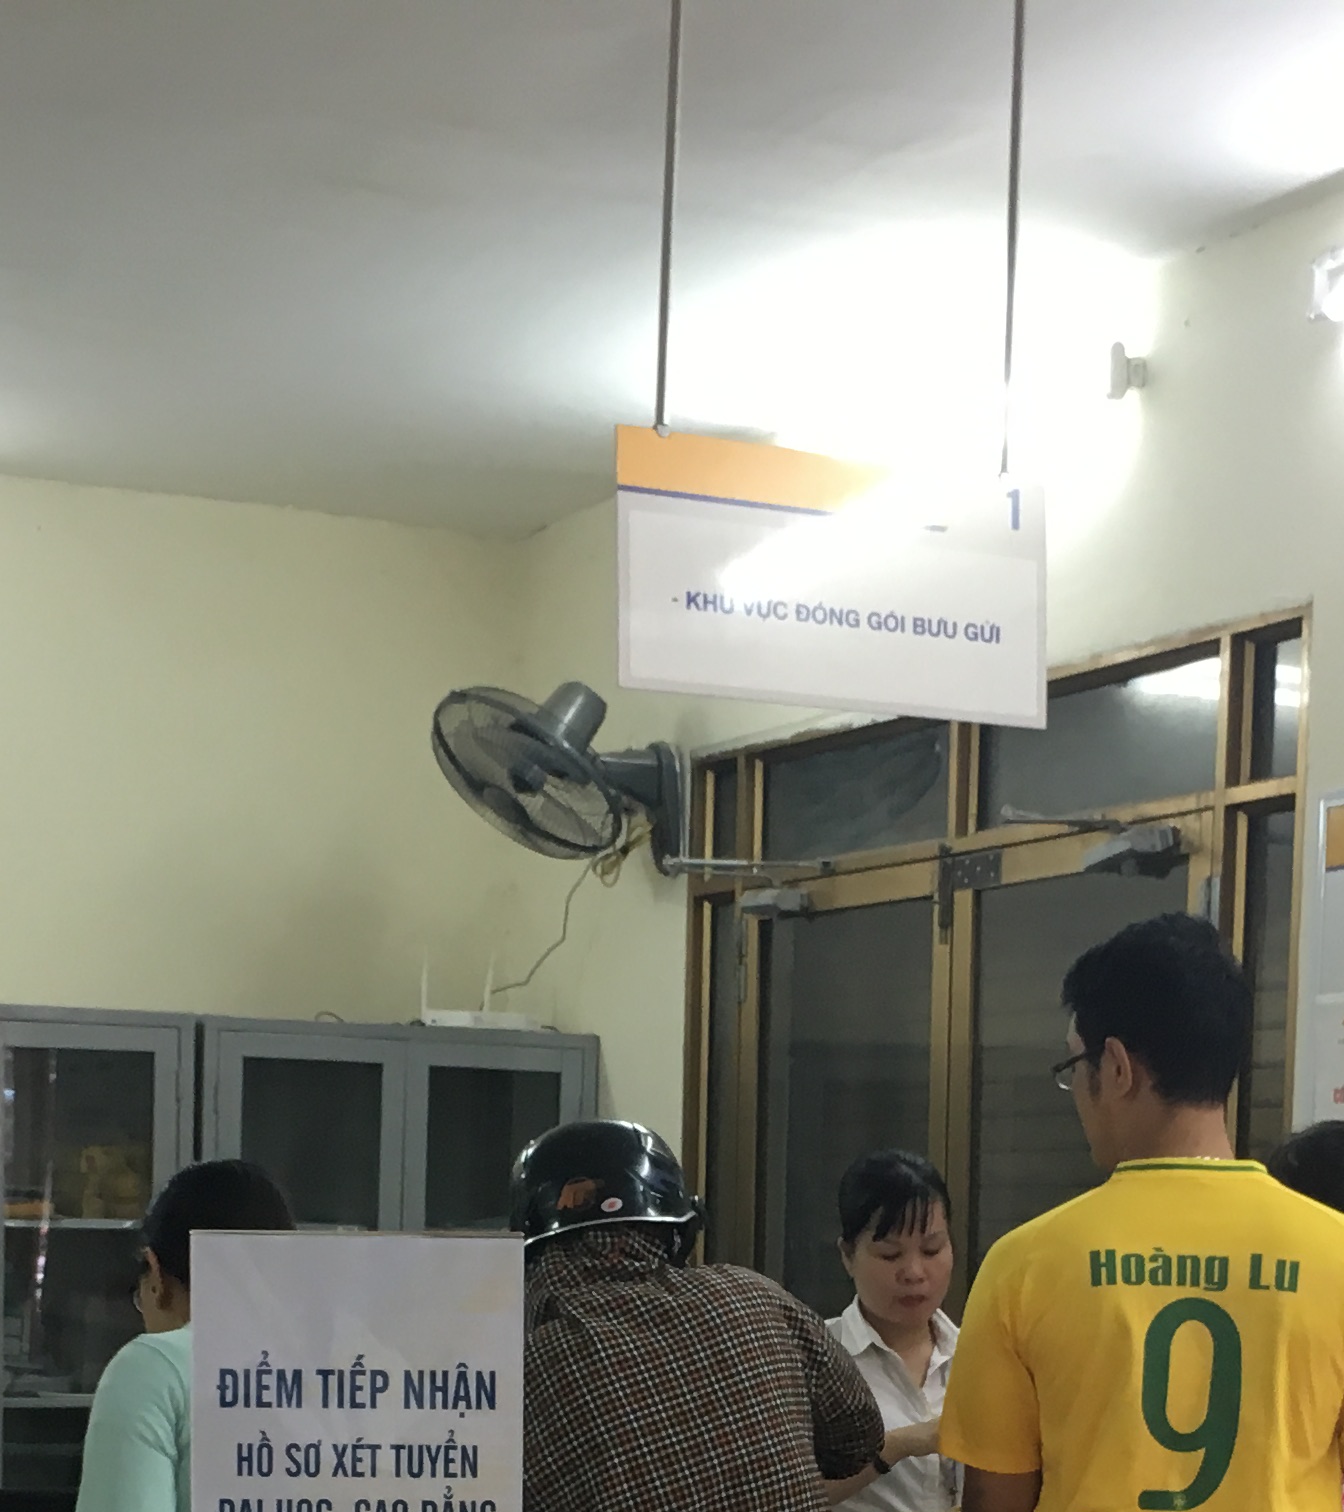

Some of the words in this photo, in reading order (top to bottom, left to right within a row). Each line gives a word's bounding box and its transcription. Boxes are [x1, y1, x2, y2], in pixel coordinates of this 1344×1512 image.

[1006, 488, 1021, 531] 1
[685, 591, 734, 614] KHU
[795, 600, 860, 629] ĐÓNG
[912, 616, 957, 640] BƯU
[964, 618, 1001, 644] GỬI
[1089, 1247, 1229, 1292] Hoàng
[1249, 1253, 1301, 1293] Lu
[217, 1350, 303, 1411] ĐIỂM
[316, 1353, 390, 1411] TIẾP
[403, 1362, 497, 1419] NHẬN
[1138, 1297, 1242, 1512] 9
[236, 1430, 272, 1478] HỒ
[285, 1439, 322, 1478] SƠ
[332, 1436, 382, 1478] XÉT
[390, 1430, 479, 1478] TUYỂN
